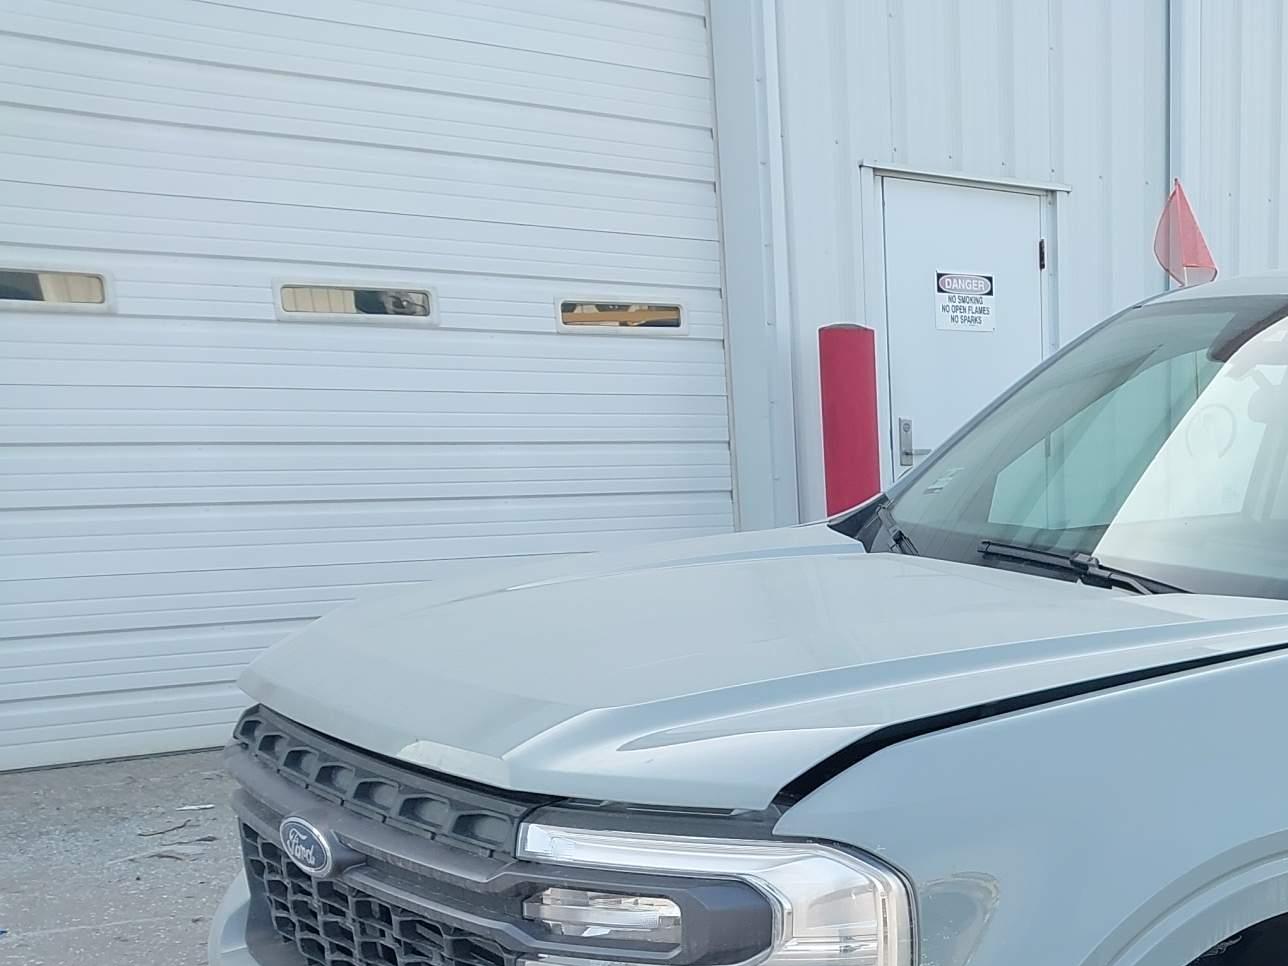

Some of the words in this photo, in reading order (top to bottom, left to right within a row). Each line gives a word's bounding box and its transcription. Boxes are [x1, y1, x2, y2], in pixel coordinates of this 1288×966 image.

[944, 278, 985, 290] DANGER
[948, 295, 957, 304] NO
[958, 295, 983, 305] SMOKING
[941, 304, 950, 313] NO
[951, 304, 967, 314] OPEN
[968, 305, 990, 315] FLAMES
[950, 314, 959, 323] NO
[960, 315, 982, 325] SPARKS
[286, 827, 316, 865] Ford
